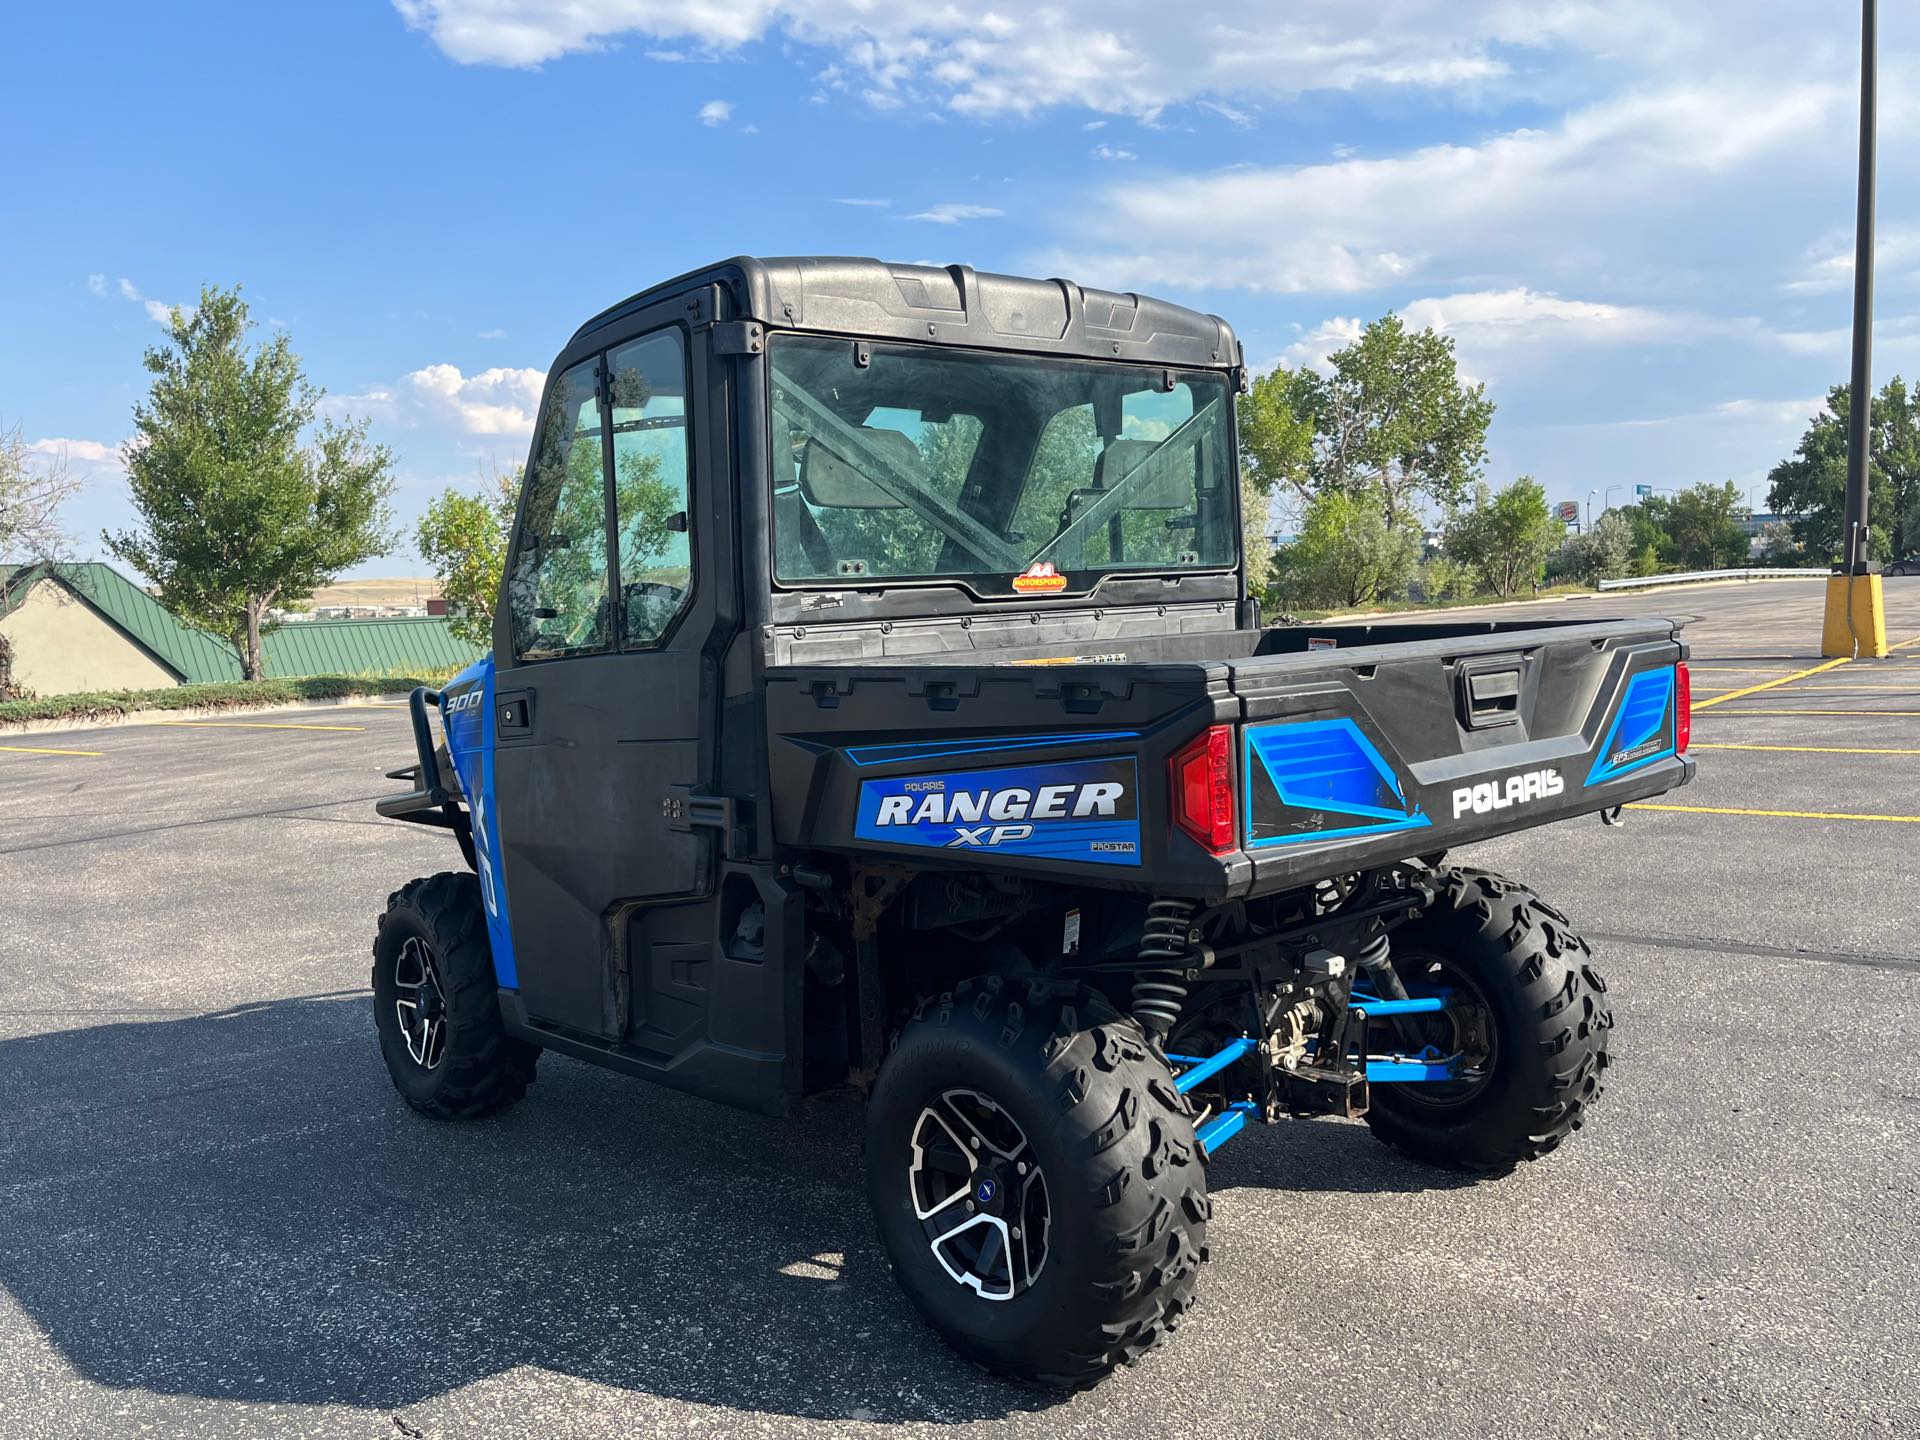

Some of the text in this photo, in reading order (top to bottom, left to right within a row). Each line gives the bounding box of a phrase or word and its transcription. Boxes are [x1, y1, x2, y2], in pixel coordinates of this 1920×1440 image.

[1014, 578, 1065, 587] MOTORSPORTS
[445, 690, 483, 715] 900
[904, 781, 945, 792] POLARIS
[1452, 768, 1564, 819] POLARIS
[875, 782, 1124, 826] RANGER
[945, 824, 1035, 847] XP
[1091, 842, 1135, 851] PROSTAR
